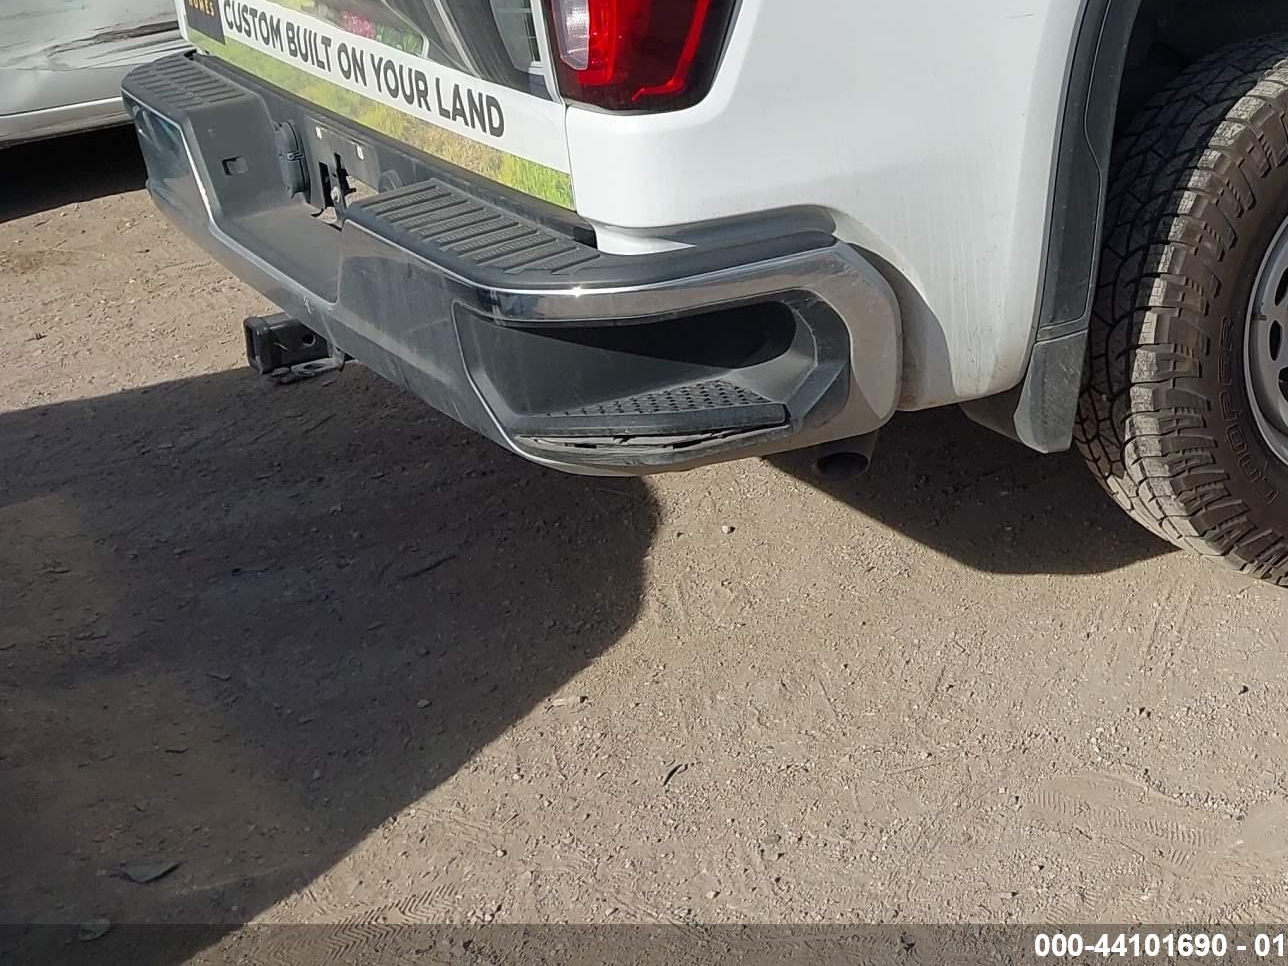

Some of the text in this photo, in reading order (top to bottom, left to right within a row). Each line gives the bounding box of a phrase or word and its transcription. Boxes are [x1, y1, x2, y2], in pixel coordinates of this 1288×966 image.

[286, 19, 332, 71] BUILT
[338, 42, 368, 86] ON
[370, 48, 432, 111] YOUR
[436, 75, 504, 138] LAND
[1217, 314, 1281, 506] COOPER
